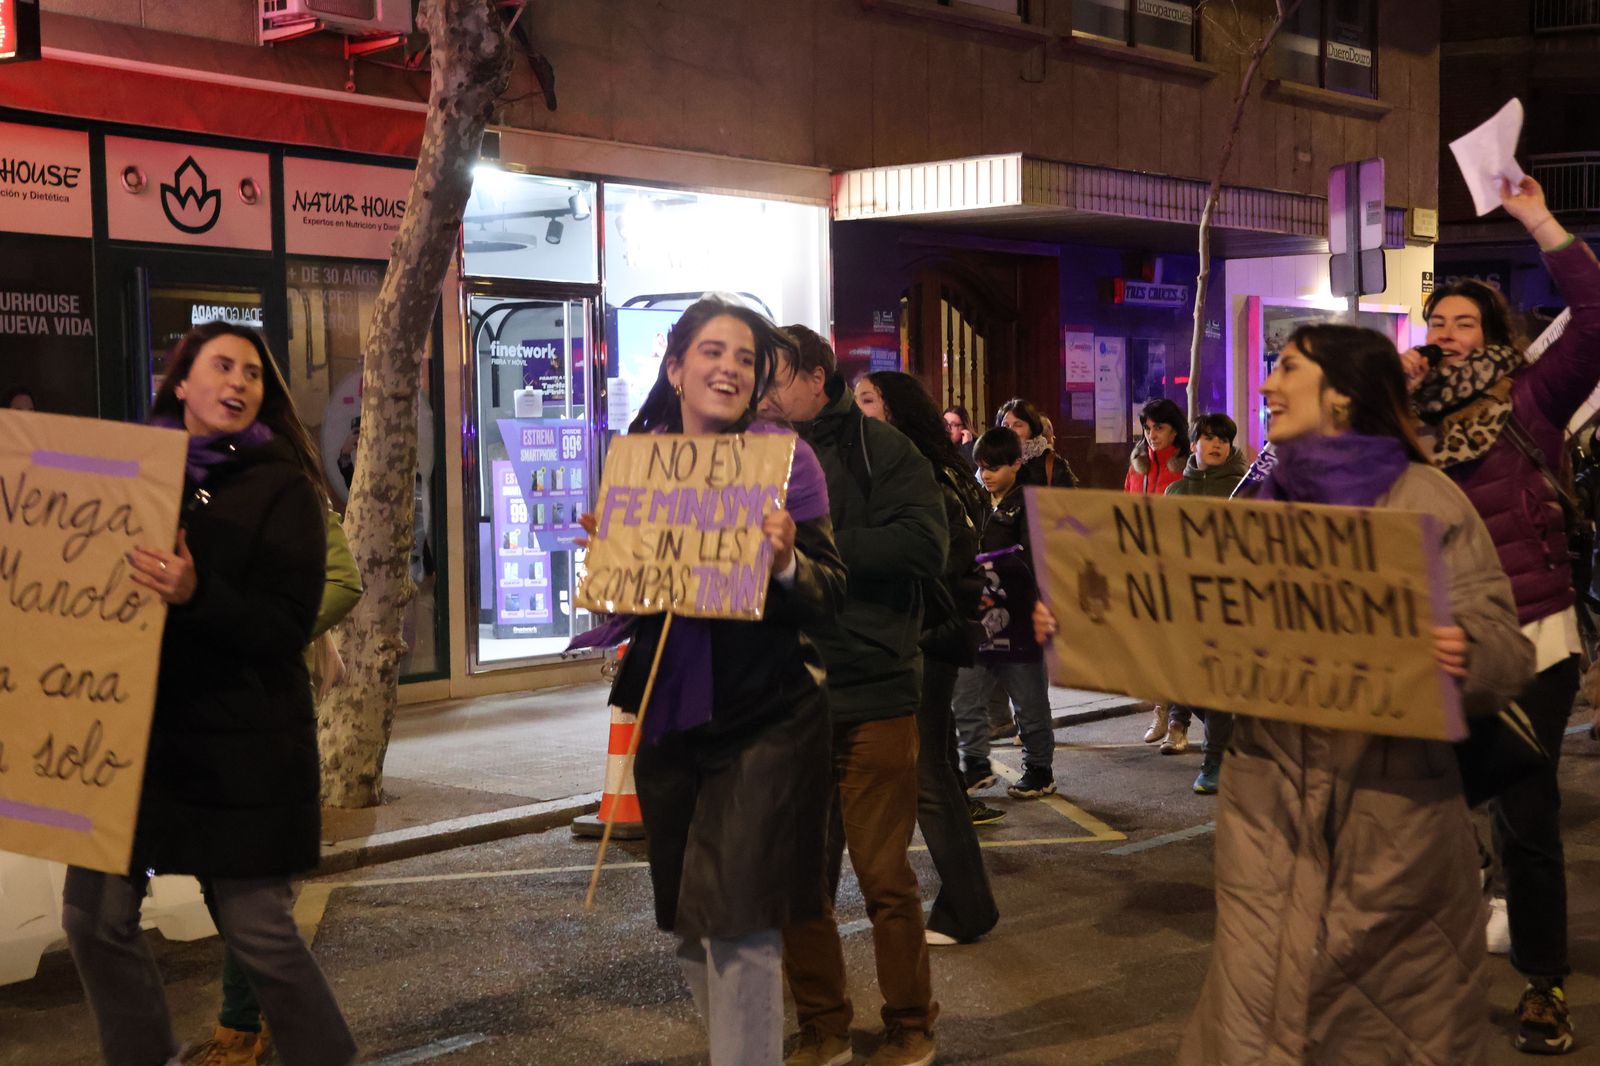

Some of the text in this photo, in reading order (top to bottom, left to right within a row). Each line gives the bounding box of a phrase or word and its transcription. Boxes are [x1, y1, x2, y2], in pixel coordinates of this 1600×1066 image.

[0, 158, 81, 188] HOUSE
[22, 191, 28, 200] y
[30, 190, 70, 202] Dietética
[292, 190, 406, 218] NATUR HOUS
[302, 216, 334, 227] Expertos
[345, 220, 377, 230] Nutrición
[302, 266, 319, 283] DE
[323, 266, 339, 284] 30
[342, 265, 378, 285] AÑOS
[0, 292, 81, 313] URHOUSE
[54, 316, 94, 336] VIDA
[490, 340, 556, 359] finetwork
[523, 429, 555, 446] ESTRENA
[647, 437, 746, 488] NO ES
[0, 472, 144, 564] Venga
[597, 484, 782, 541] FEMINISMO
[632, 527, 748, 562] SIN LES
[1112, 499, 1379, 574] NI MACHISMI
[585, 563, 691, 607] COMPAS
[1123, 562, 1420, 639] NI FEMINISMI
[38, 662, 130, 704] cena
[32, 719, 134, 788] solo
